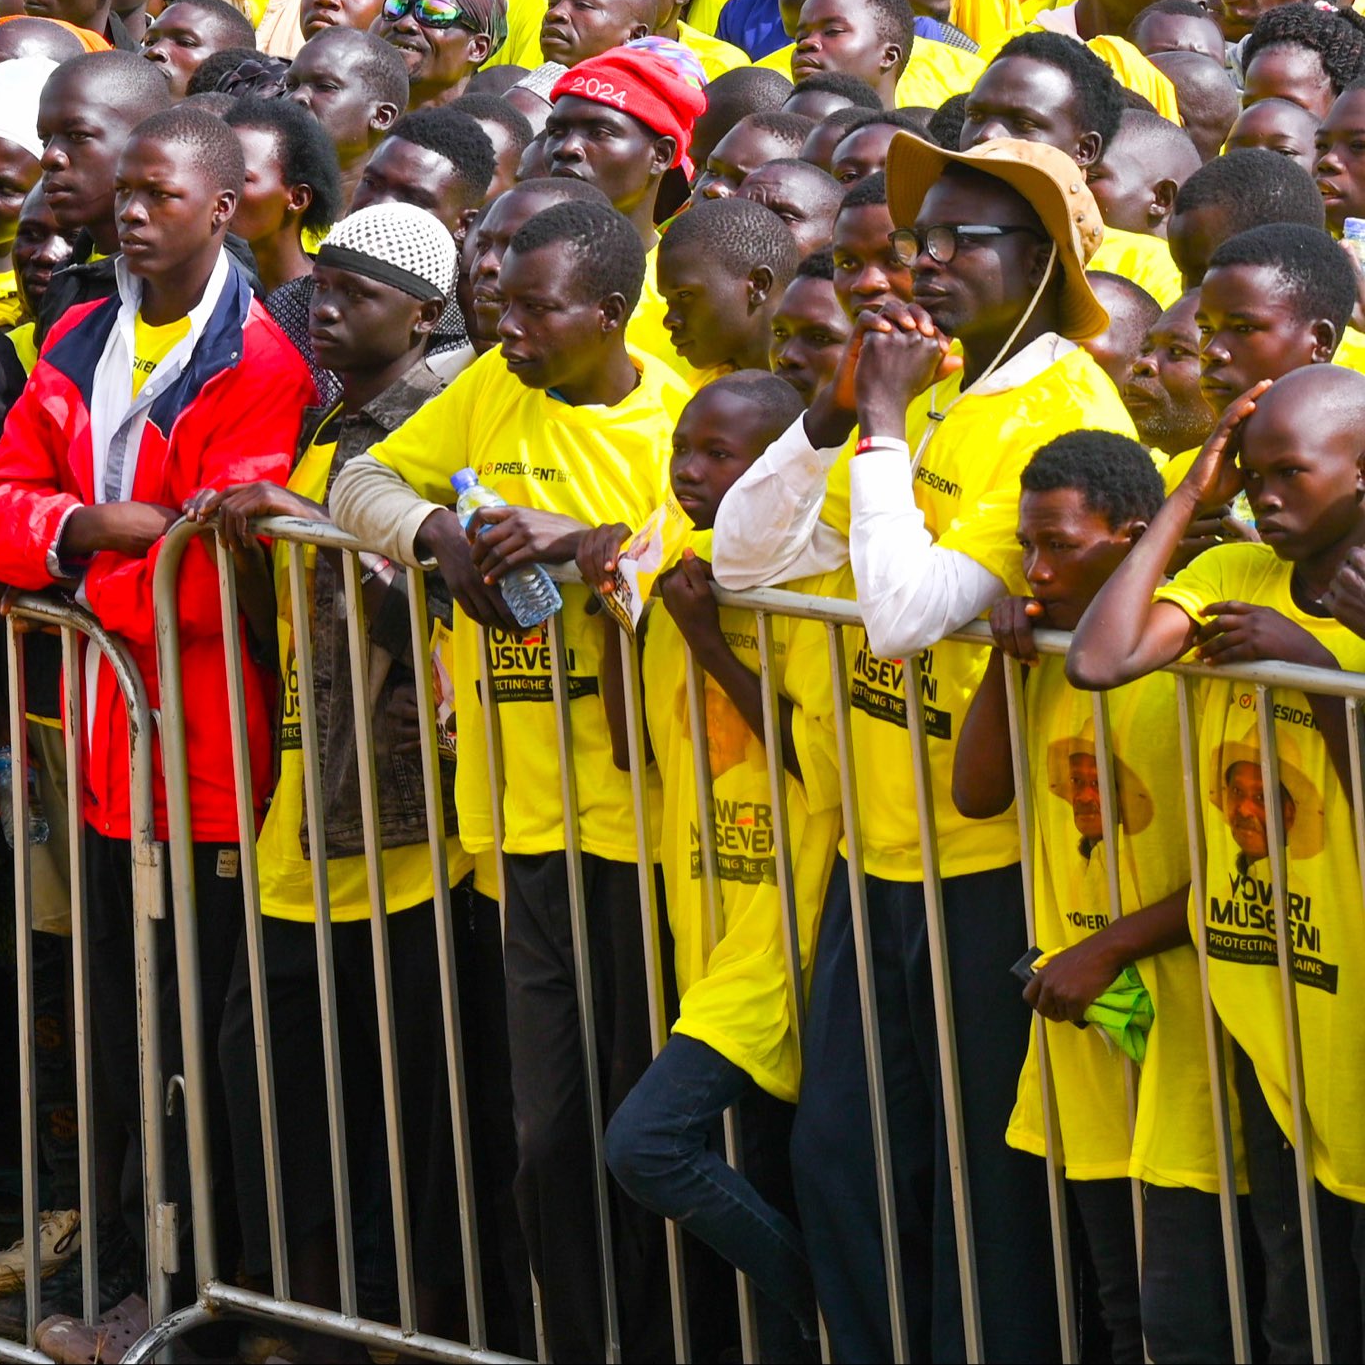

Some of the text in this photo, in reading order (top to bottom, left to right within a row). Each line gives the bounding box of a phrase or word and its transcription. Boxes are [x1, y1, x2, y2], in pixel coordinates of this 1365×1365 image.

[569, 76, 627, 108] 2024
[494, 462, 556, 482] PRESIDENT
[490, 646, 576, 671] USEVEI
[854, 650, 937, 703] MUSEVNI
[889, 698, 904, 714] THE
[716, 799, 772, 827] WER
[690, 821, 774, 853] MSEVE
[1229, 872, 1311, 922] YOWRI
[1210, 897, 1321, 954] MUSEENI
